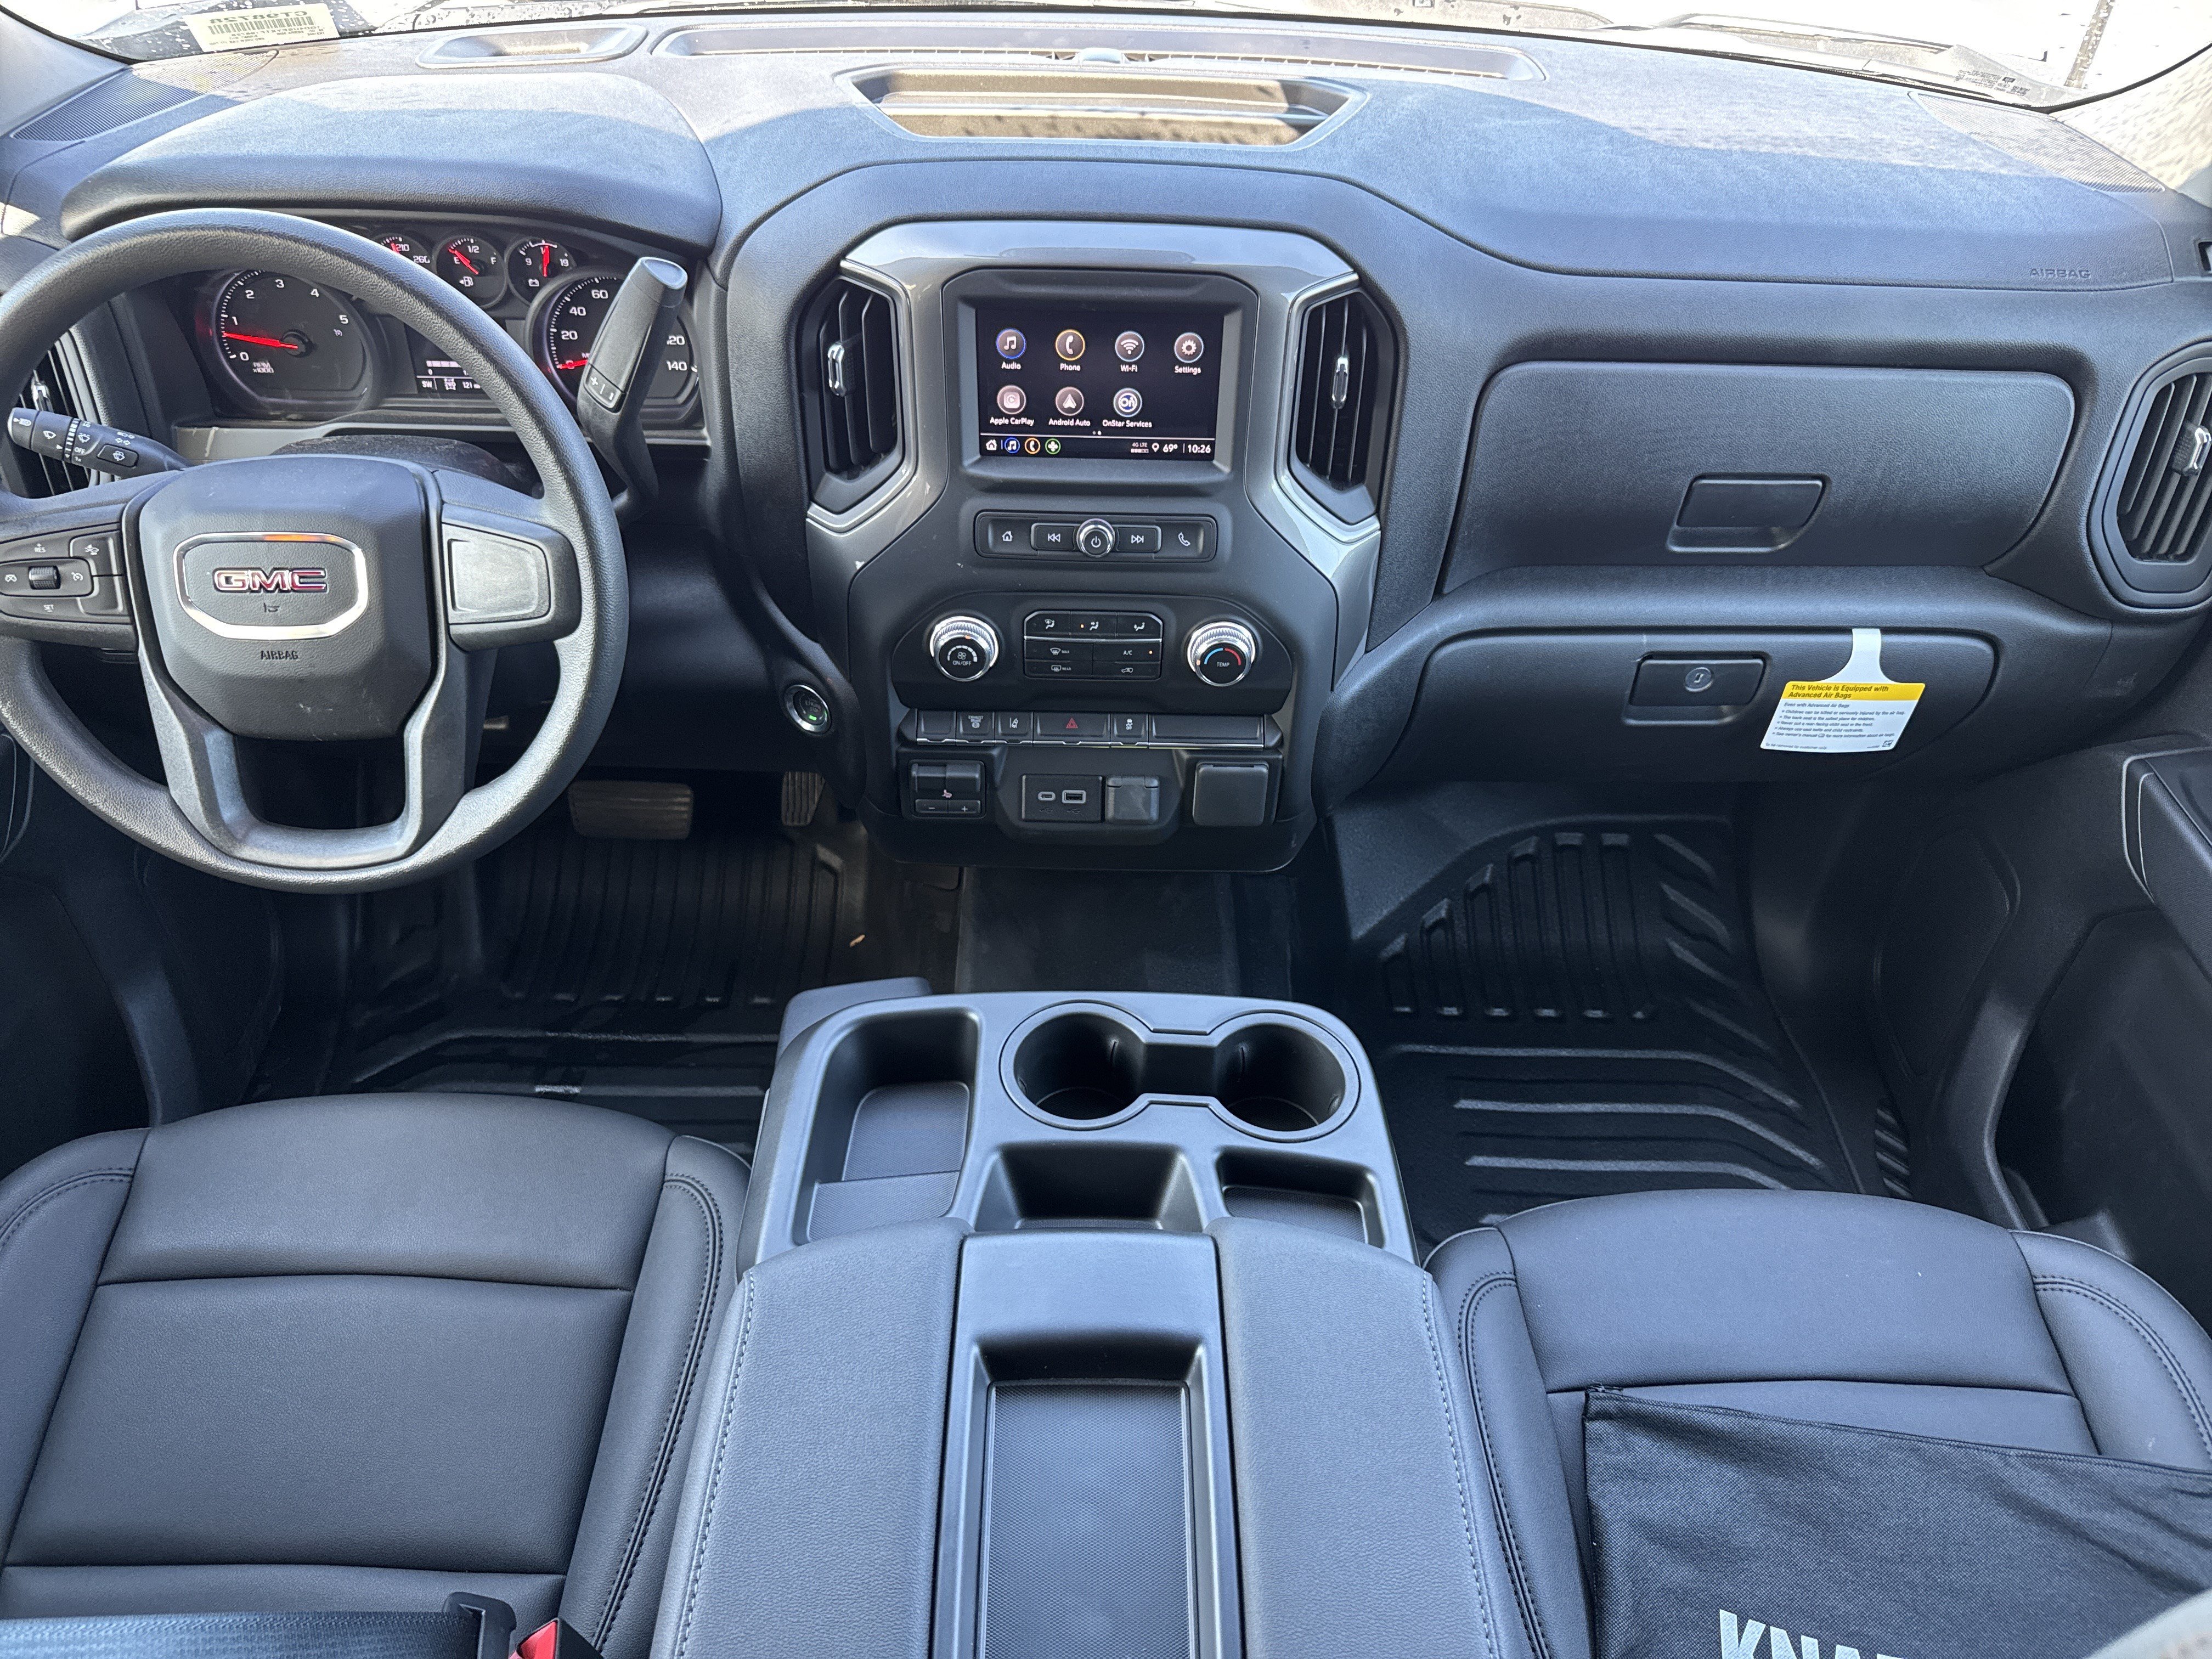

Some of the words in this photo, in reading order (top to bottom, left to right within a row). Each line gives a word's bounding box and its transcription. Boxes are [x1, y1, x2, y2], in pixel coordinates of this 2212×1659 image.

[467, 245, 480, 253] 1/2
[525, 257, 532, 266] 9
[560, 258, 569, 267] 19
[2030, 267, 2091, 279] AIRBAG
[275, 279, 285, 288] 3
[245, 290, 255, 299] 2
[310, 289, 319, 297] 4
[591, 290, 608, 299] 60
[569, 307, 586, 316] 40
[232, 317, 238, 325] 1
[339, 314, 349, 324] 5
[561, 331, 578, 340] 20
[667, 335, 685, 345] 20
[240, 352, 249, 361] 0
[667, 361, 687, 371] 140
[1001, 362, 1022, 370] Audio
[1060, 363, 1081, 371] Phone
[1175, 365, 1201, 375] Settings
[990, 417, 1009, 426] Apple
[1010, 417, 1035, 427] CarPlay
[1048, 418, 1074, 426] Android
[1102, 419, 1125, 427] OnStar
[1126, 420, 1153, 428] Services
[1188, 444, 1211, 454] 10:26
[214, 568, 328, 592] GMC
[261, 650, 299, 660] AIRBAG
